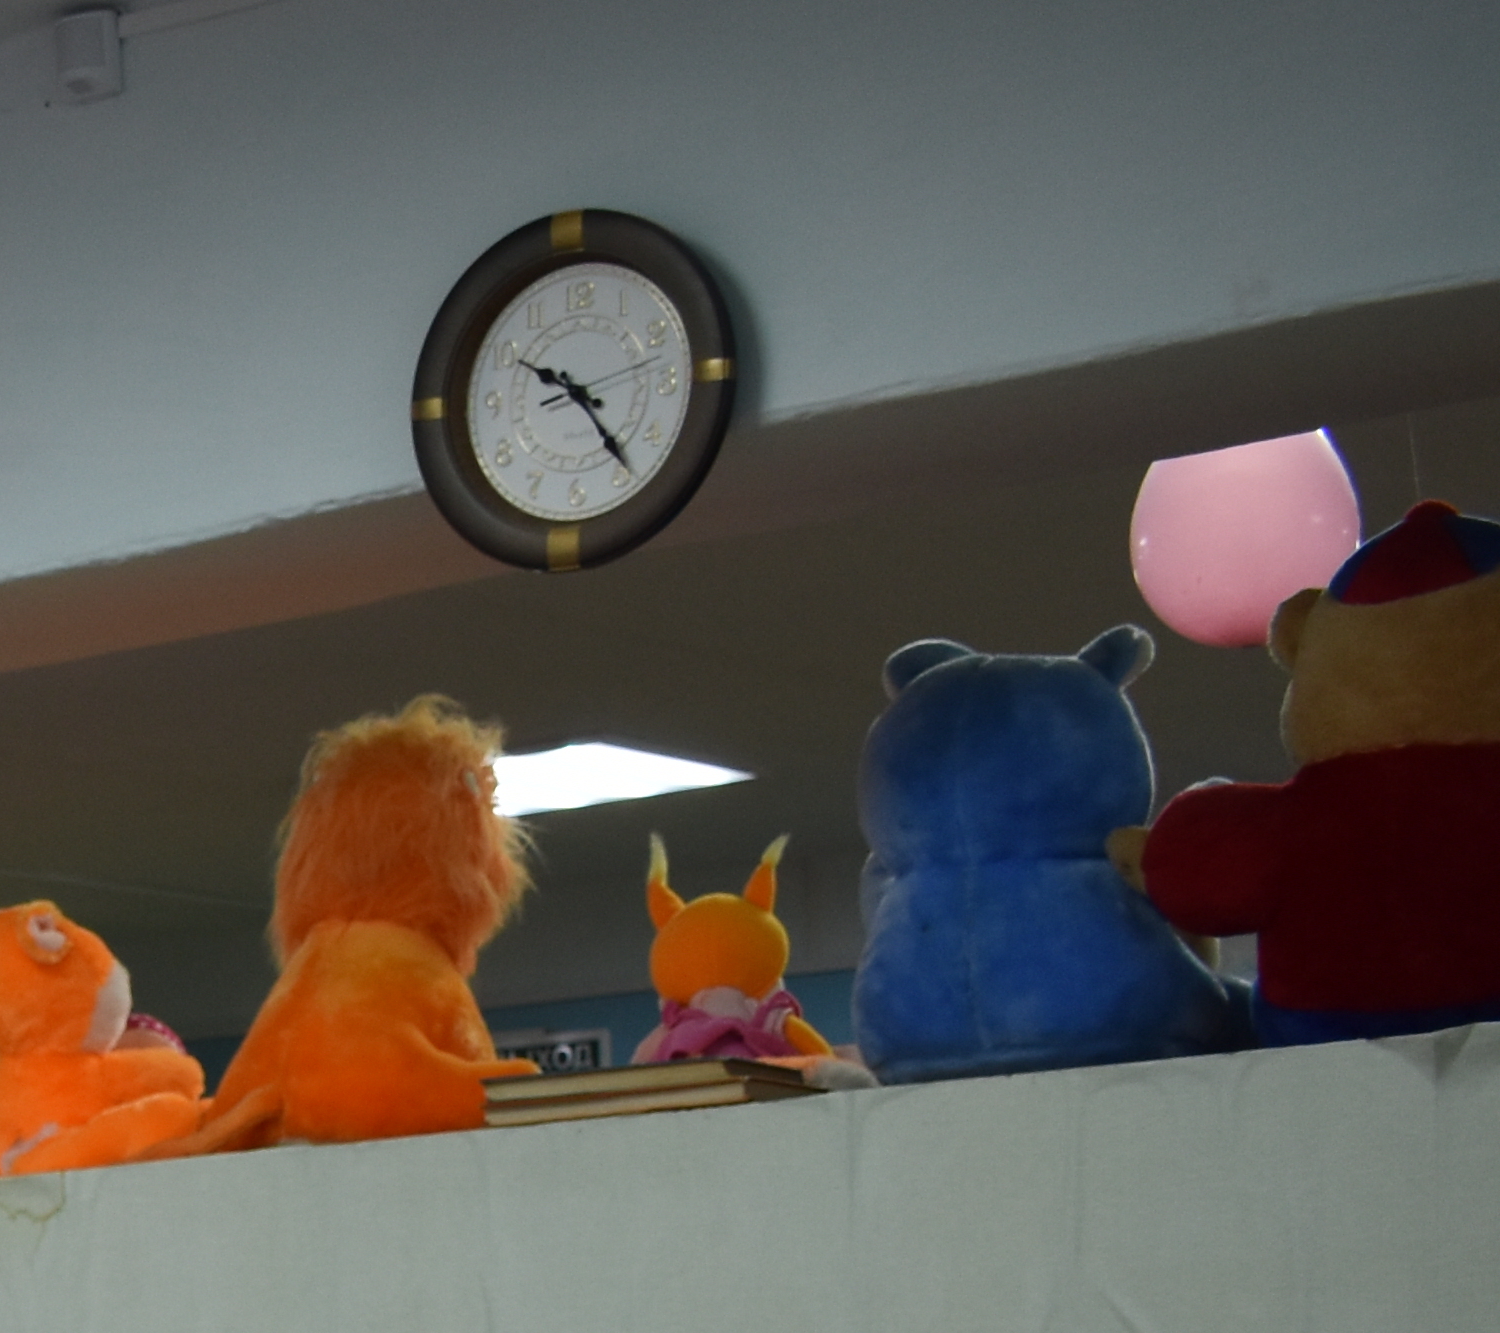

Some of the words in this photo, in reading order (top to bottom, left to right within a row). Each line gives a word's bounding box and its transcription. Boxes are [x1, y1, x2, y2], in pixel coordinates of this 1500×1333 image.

[566, 281, 595, 312] 12
[647, 319, 667, 347] 2
[493, 340, 518, 370] 10
[656, 366, 677, 396] 3
[485, 390, 502, 419] 9
[642, 420, 662, 446] 4
[496, 438, 513, 467] 8
[526, 469, 544, 500] 7
[568, 478, 587, 507] 6
